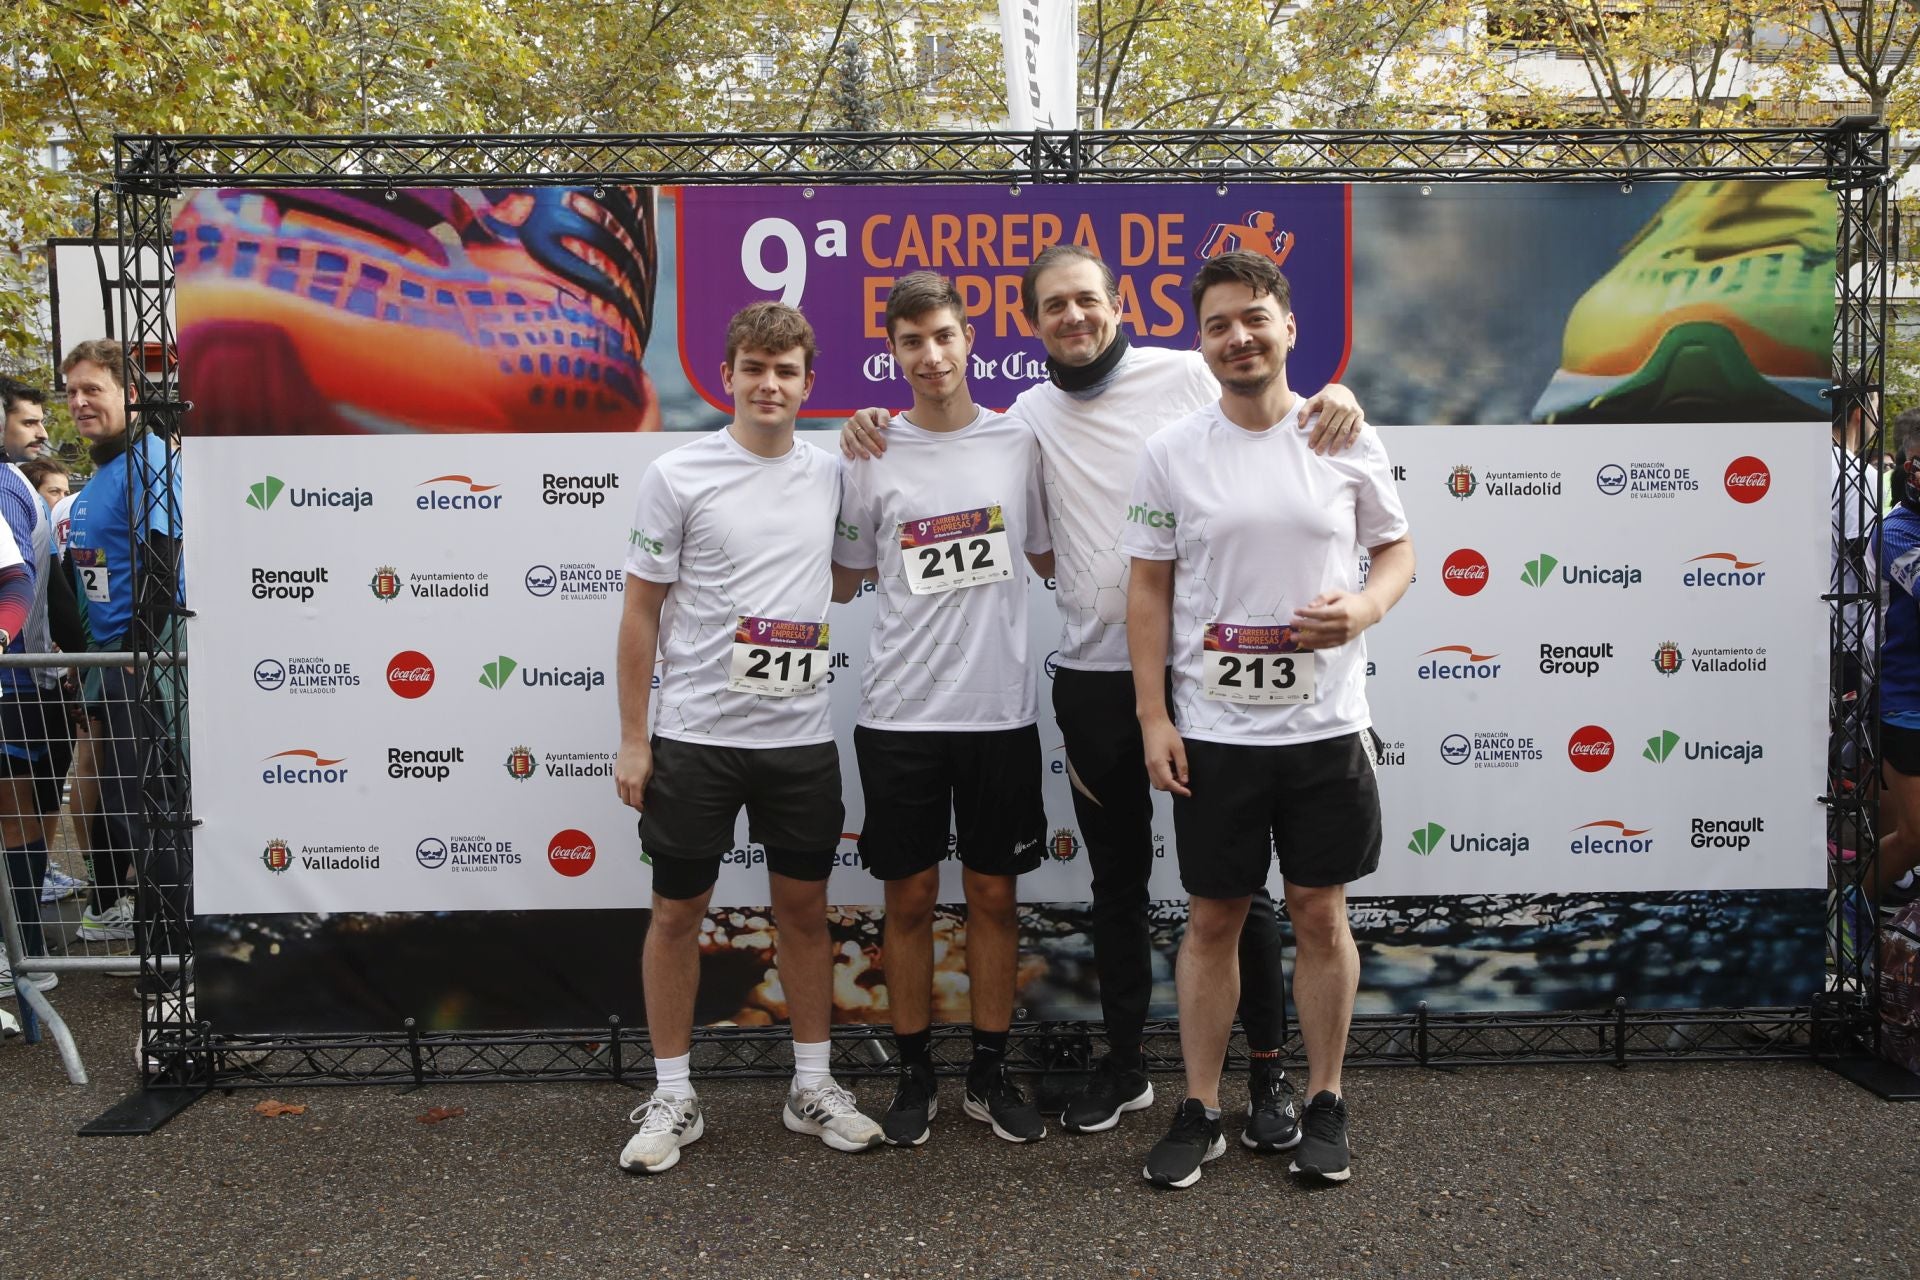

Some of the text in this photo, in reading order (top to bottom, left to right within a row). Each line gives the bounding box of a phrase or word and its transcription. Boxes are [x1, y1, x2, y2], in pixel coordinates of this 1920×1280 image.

[861, 213, 1185, 267] CARRERA DE
[972, 353, 998, 380] de
[543, 473, 619, 489] Renault
[1486, 470, 1562, 480] Ayuntamiento de
[1631, 469, 1689, 479] BANCO DE
[1727, 473, 1767, 486] Coca-Cola
[1486, 482, 1561, 496] Valladolid
[1631, 481, 1698, 491] ALIMENTOS
[290, 487, 373, 512] Unicaja
[417, 490, 502, 510] elecnor
[543, 489, 604, 508] Group
[932, 520, 972, 533] EMPRESAS
[559, 562, 596, 570] FUNDACIÓN
[919, 539, 994, 579] 212
[252, 568, 328, 583] Renault
[411, 572, 488, 582] Ayuntamiento de
[561, 570, 621, 580] BANCO DE
[1445, 565, 1486, 579] Coca-Cola
[1563, 565, 1641, 589] Unicaja
[1684, 568, 1765, 586] elecnor
[252, 584, 314, 602] Group
[411, 583, 488, 597] Valladolid
[561, 581, 626, 592] ALIMENTO
[570, 593, 607, 601] VALLADOLID
[771, 630, 806, 640] EMPRESAS
[1238, 636, 1279, 645] EMPRESAS
[1541, 643, 1613, 658] Renault
[1692, 646, 1767, 657] Ayuntamiento de
[289, 664, 350, 674] BANCO DE
[745, 648, 812, 682] 211
[1418, 660, 1500, 679] elecnor
[1540, 659, 1599, 677] Group
[1692, 658, 1766, 672] Valladolid
[389, 668, 431, 681] Coca-Cola
[523, 667, 604, 691] Unicaja
[1218, 656, 1296, 689] 213
[290, 676, 360, 686] ALIMENTOS
[1474, 731, 1509, 739] FUNDACIÓN
[1393, 740, 1405, 749] de
[1475, 738, 1533, 749] BANCO DE
[1571, 742, 1611, 755] Coca-Cola
[388, 747, 464, 763] Renault
[546, 752, 609, 762] Ayuntamiento
[1475, 750, 1542, 760] ALIMENTOS
[1685, 741, 1762, 764] Unicaja
[263, 765, 348, 784] elecnor
[388, 764, 450, 782] Group
[546, 763, 612, 777] Valladoli
[1692, 817, 1764, 833] Renault
[450, 834, 486, 842] FUNDACIÓN
[1451, 833, 1529, 856] Unicaja
[1571, 835, 1653, 854] elecnor
[1691, 833, 1750, 851] Group
[302, 844, 380, 855] Ayuntamiento de
[451, 842, 512, 853] BANCO DE
[551, 846, 592, 859] Coca-Cola
[302, 856, 379, 869] Valladolid
[452, 854, 521, 864] ALIMENTOS
[720, 845, 764, 869] caja
[460, 865, 498, 873] VALLADOLID
